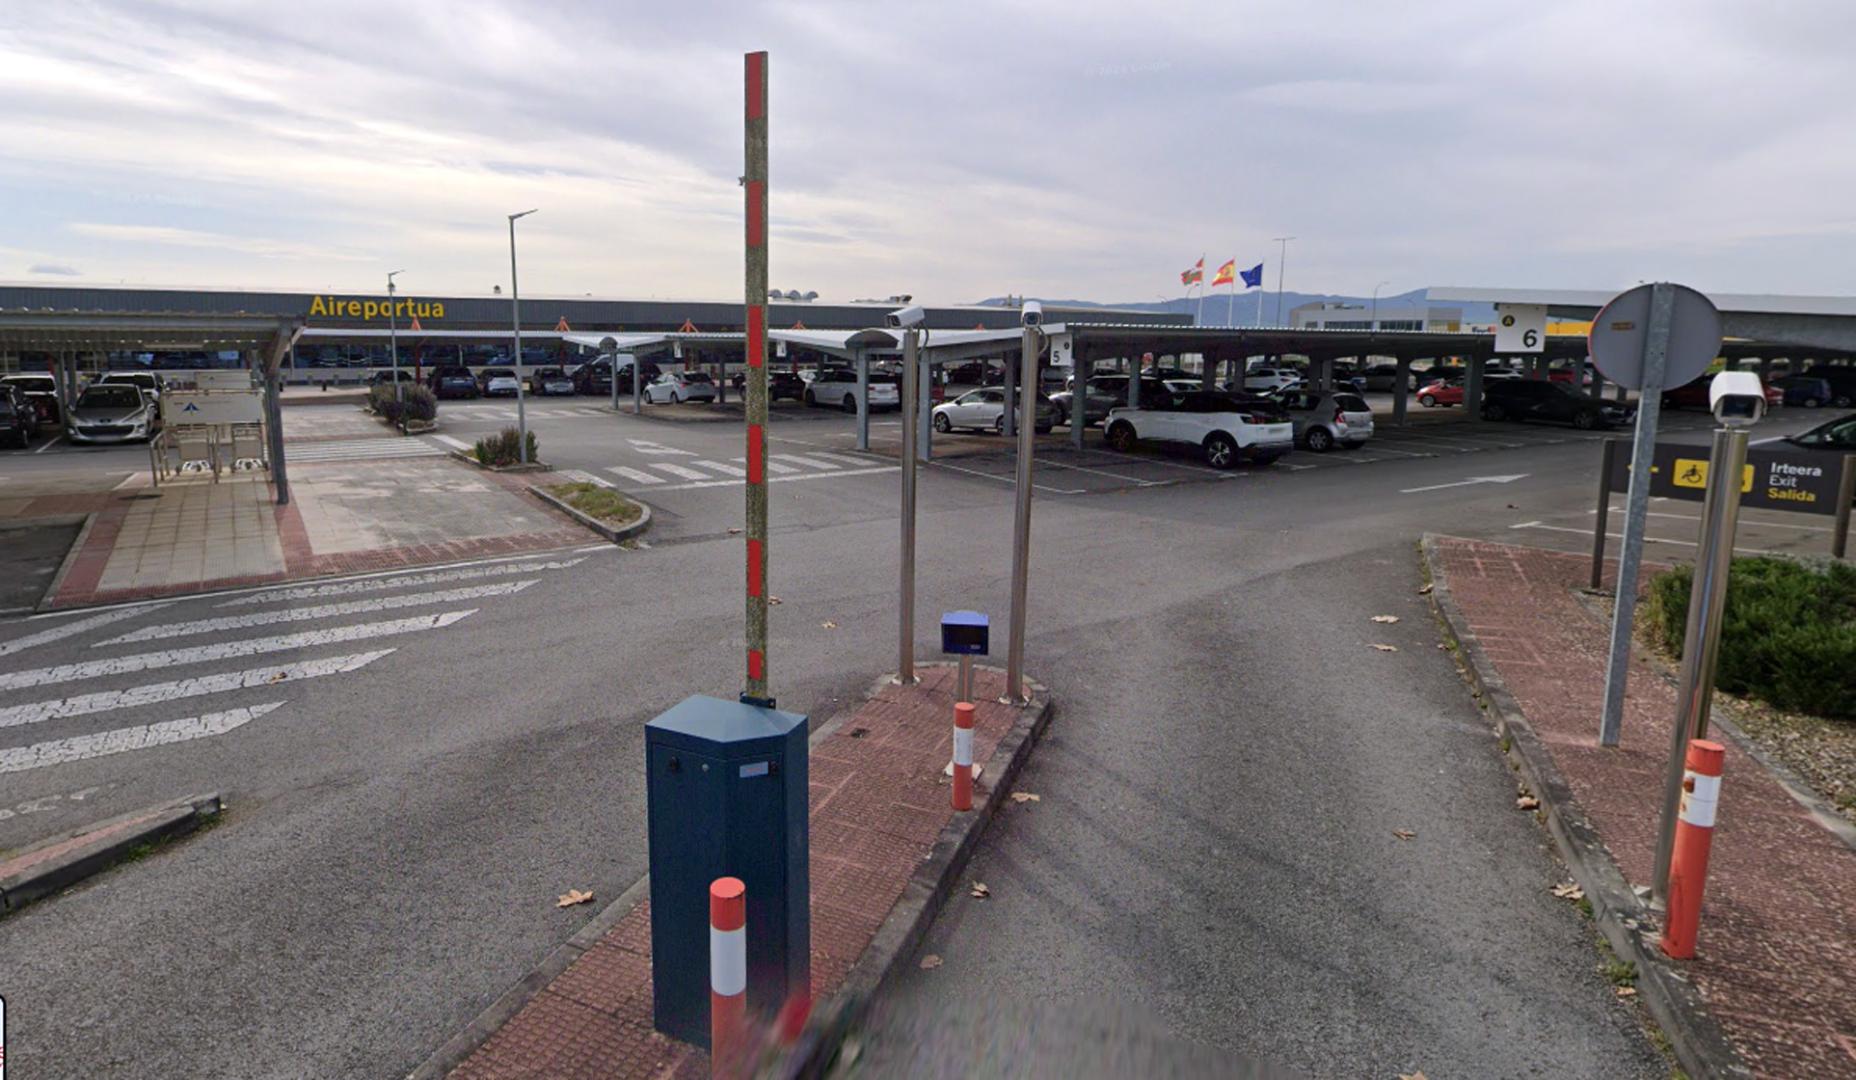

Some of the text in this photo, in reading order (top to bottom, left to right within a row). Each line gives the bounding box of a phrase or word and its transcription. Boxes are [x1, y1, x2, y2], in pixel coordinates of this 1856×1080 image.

[309, 294, 445, 320] Aireportua
[1523, 329, 1538, 348] 6
[1053, 350, 1060, 363] 5
[1770, 462, 1822, 477] Irteera
[1769, 474, 1798, 487] Exit
[1768, 487, 1816, 502] Salida
